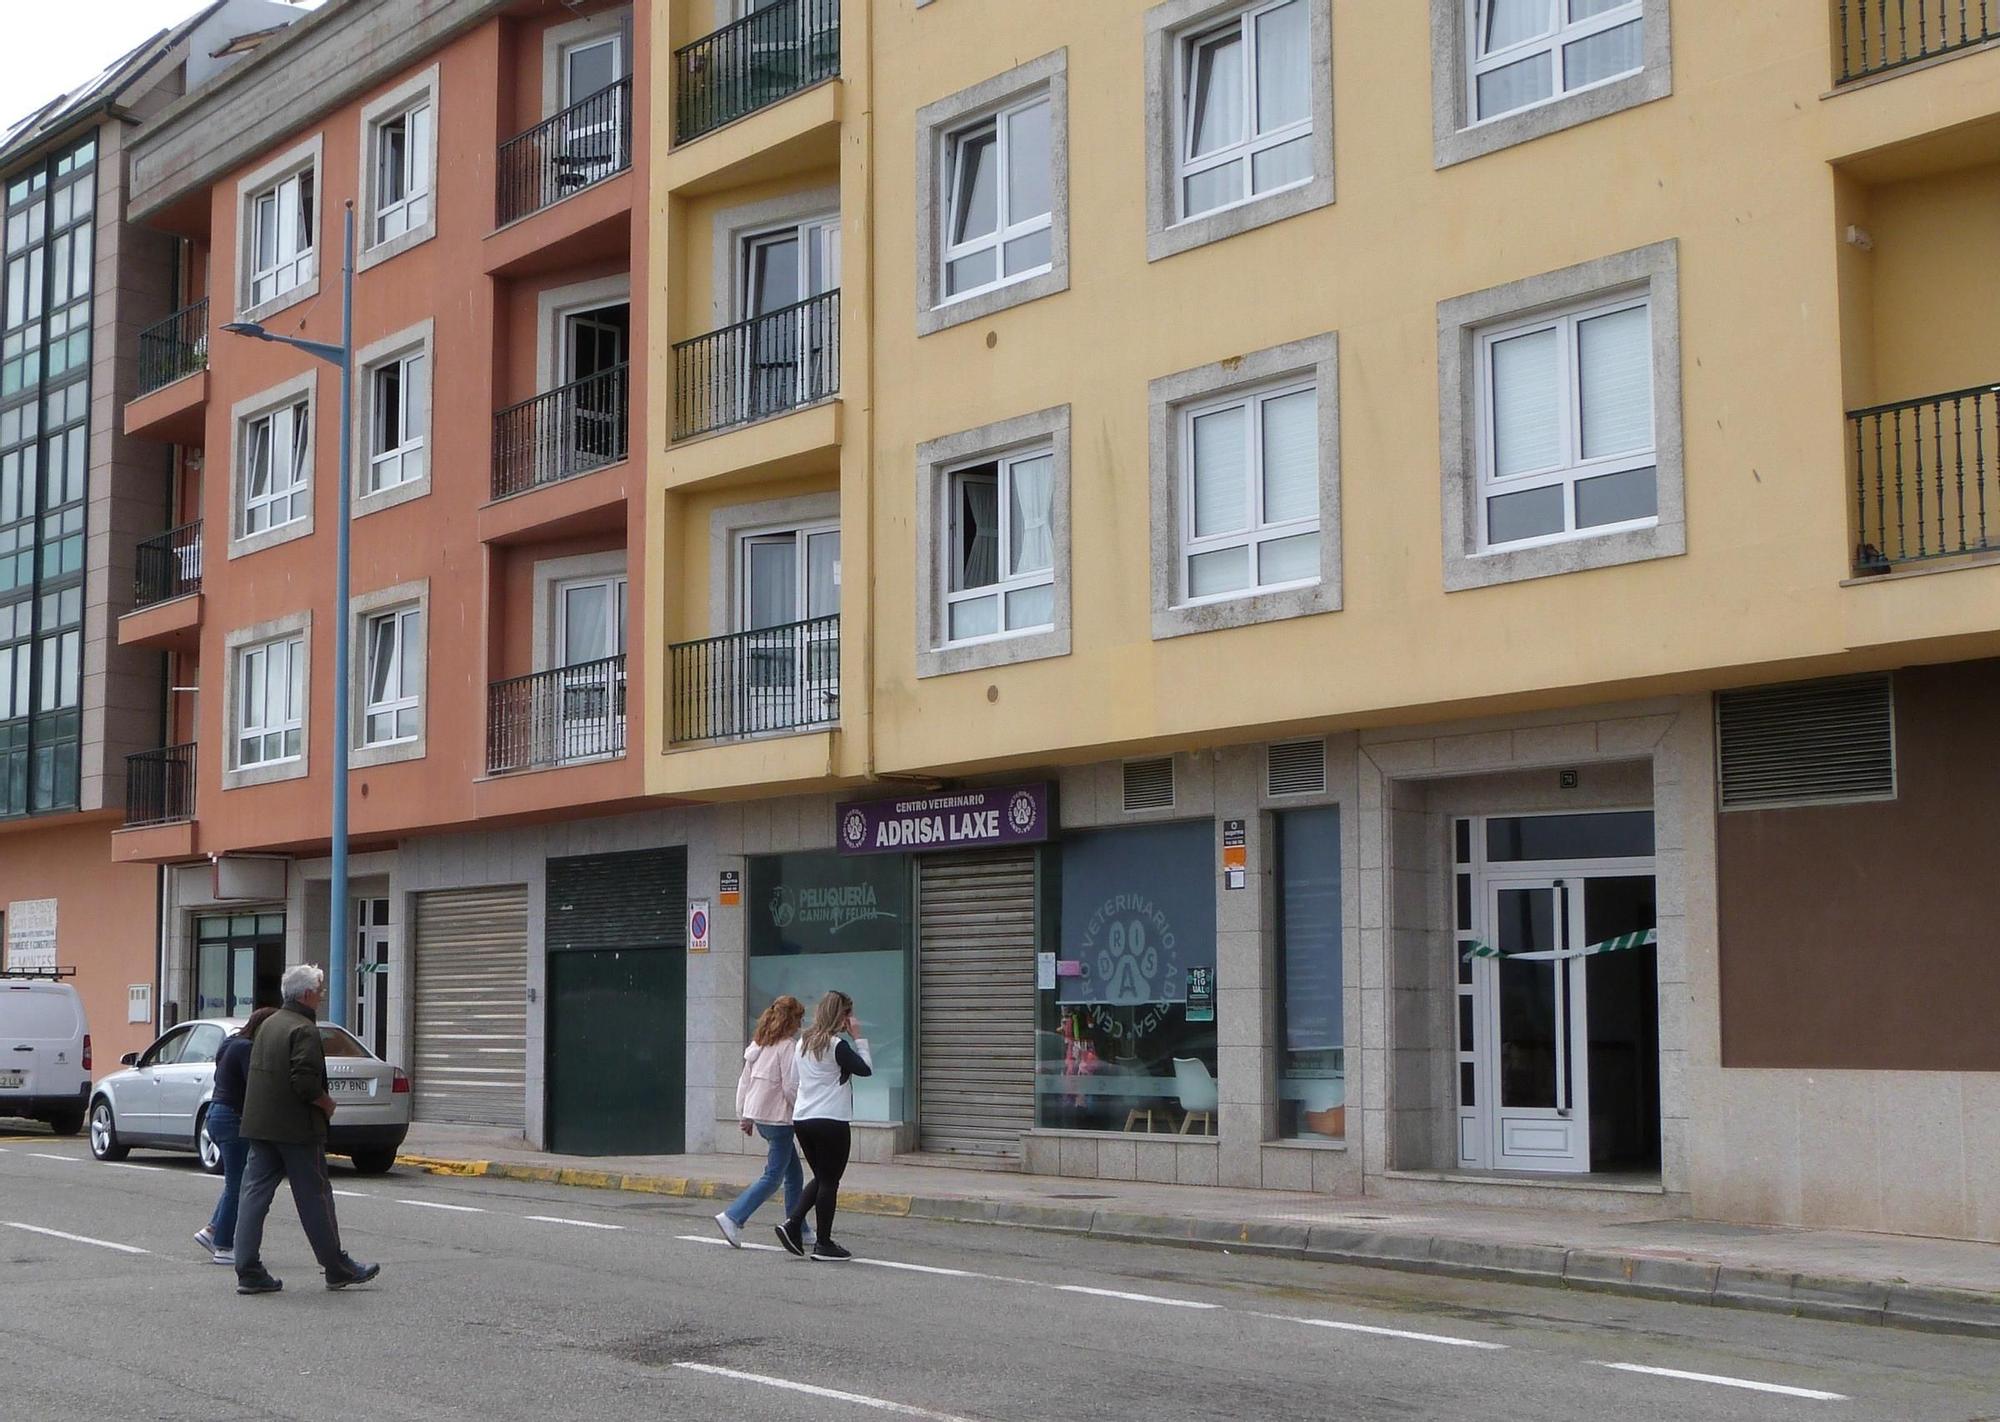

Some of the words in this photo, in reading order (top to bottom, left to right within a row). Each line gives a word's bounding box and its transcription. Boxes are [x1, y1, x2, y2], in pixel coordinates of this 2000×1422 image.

[896, 799, 927, 813] CENTRO
[928, 794, 984, 810] VETERINARIO
[876, 816, 945, 847] ADRISA
[949, 810, 1000, 841] LAXE
[800, 881, 877, 907] PELUQUERÍA
[1081, 893, 1176, 949] VETERINARIO
[691, 940, 707, 948] VADO
[328, 1080, 346, 1091] 097
